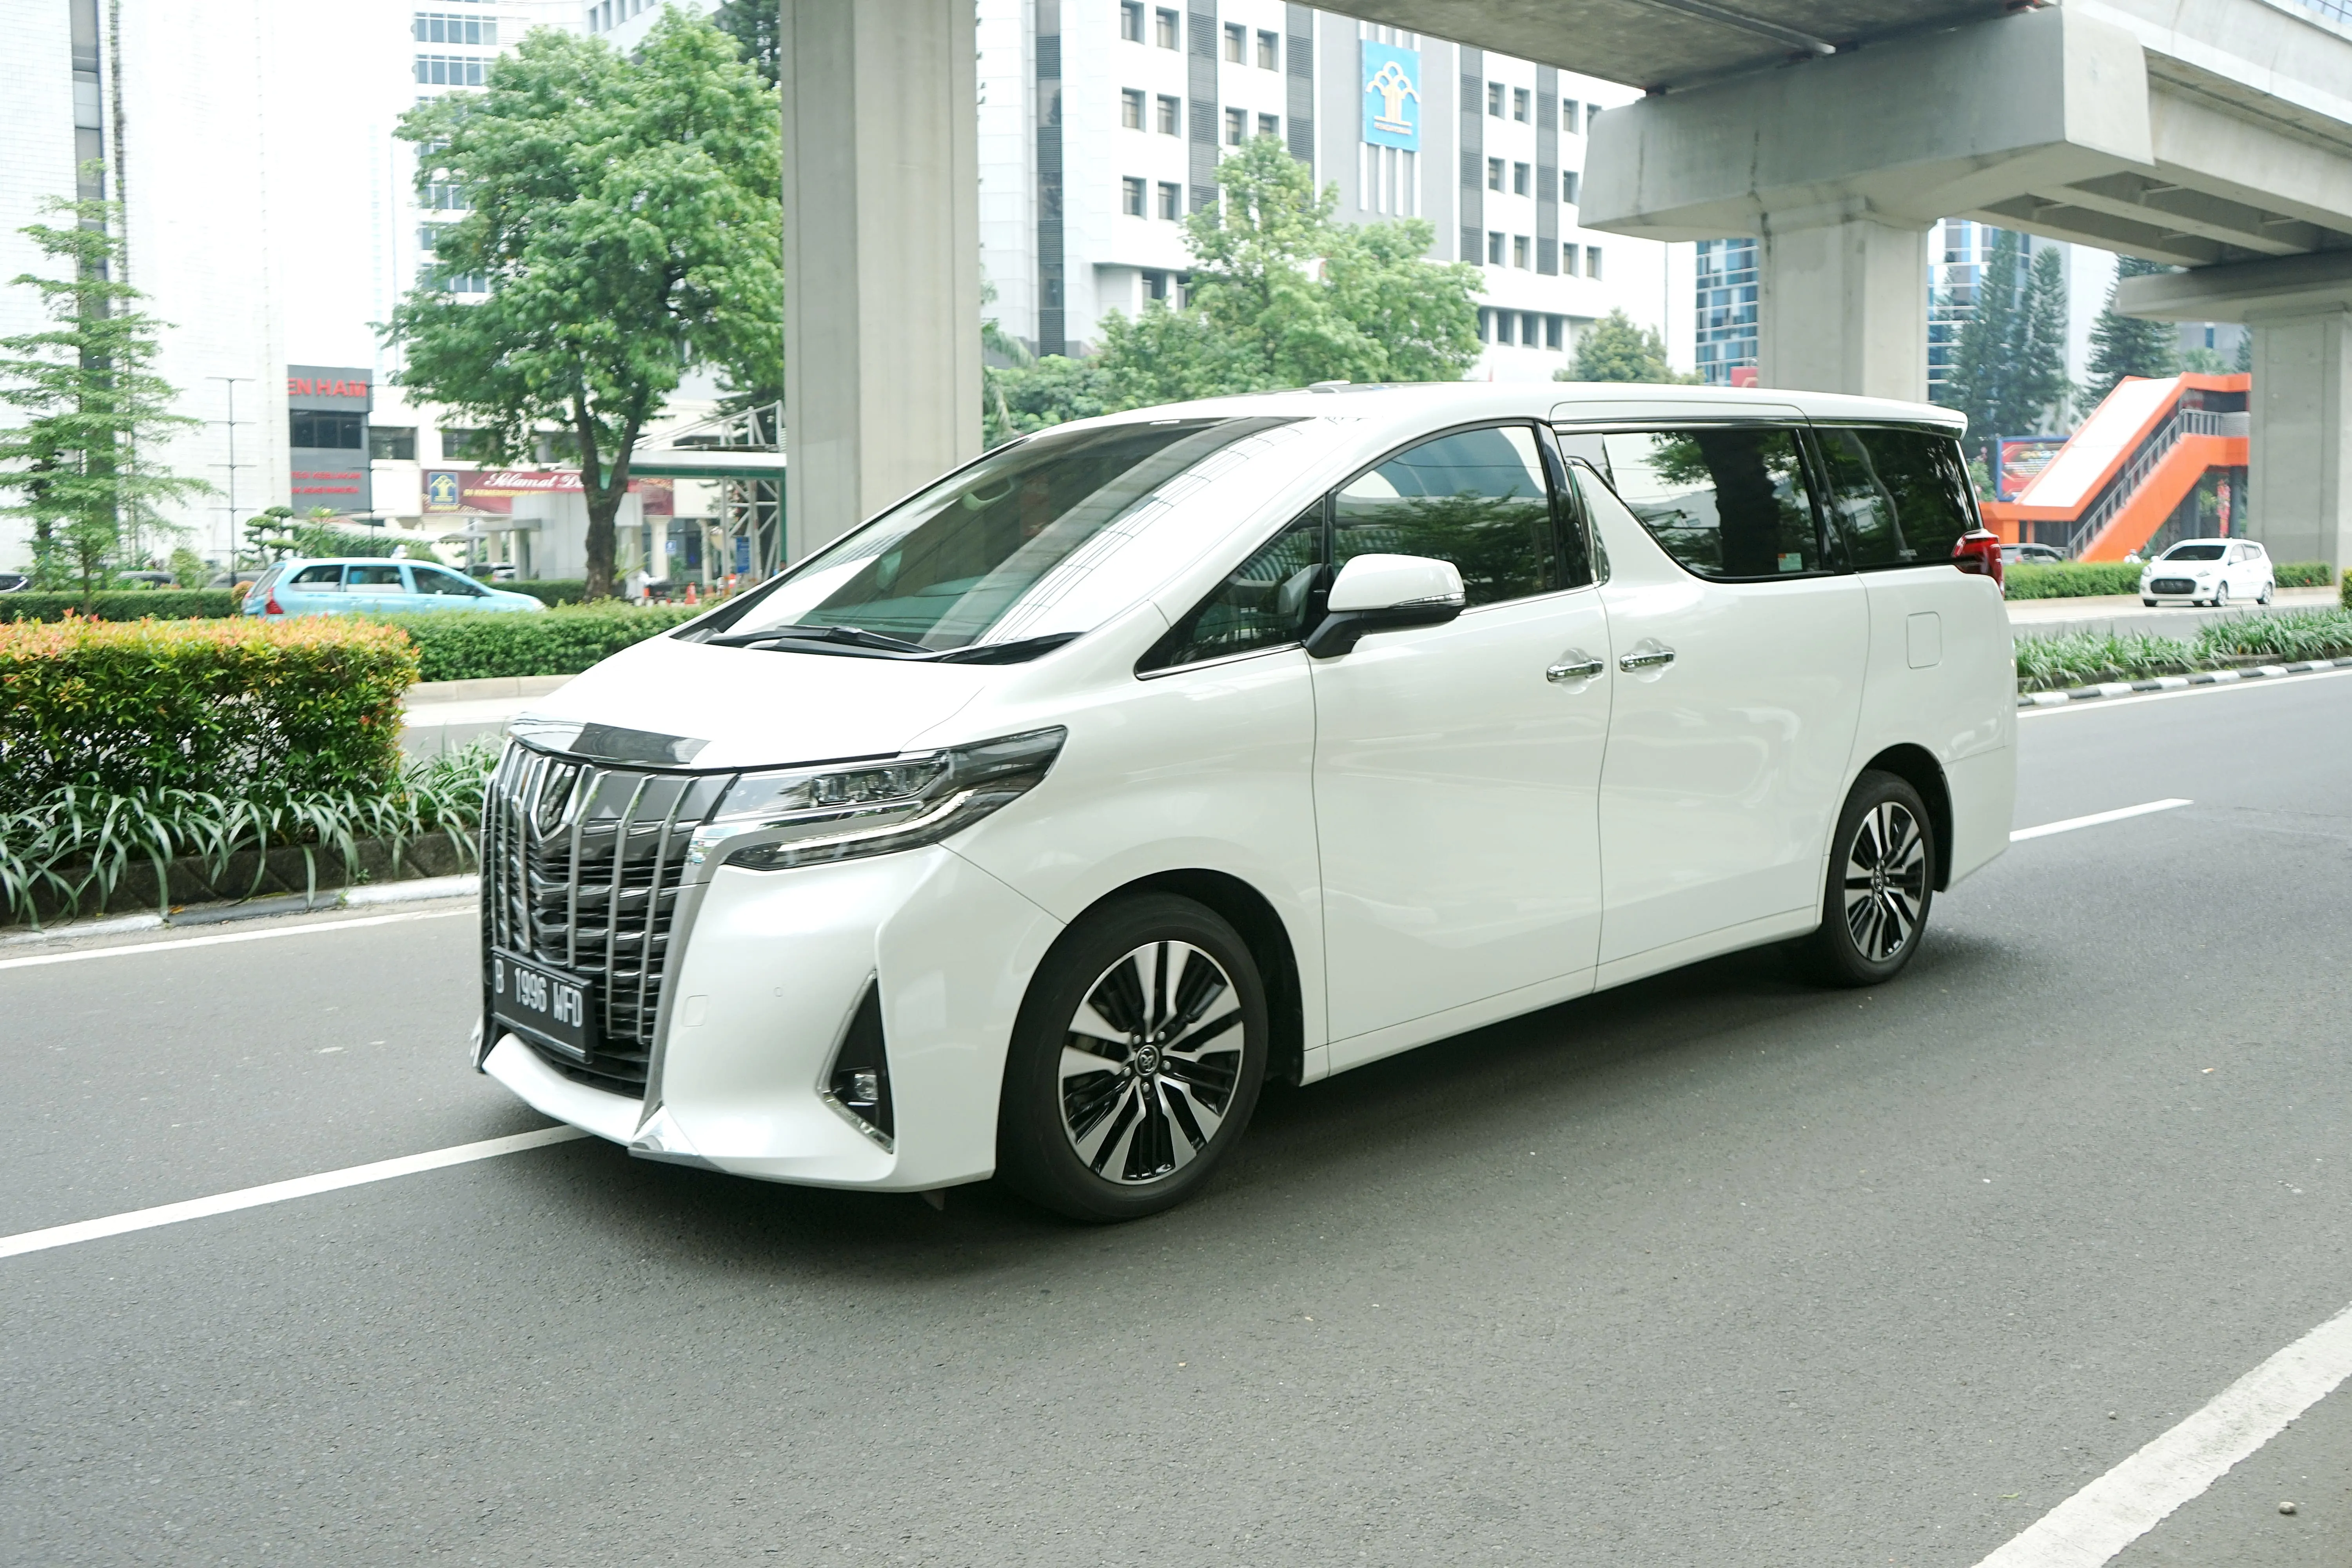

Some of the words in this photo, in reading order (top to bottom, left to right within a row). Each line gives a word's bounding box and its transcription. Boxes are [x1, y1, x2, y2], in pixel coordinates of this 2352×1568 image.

[316, 378, 367, 397] HAM
[483, 472, 558, 488] Selamat
[495, 959, 504, 993] B
[514, 967, 547, 1012] 1996
[553, 982, 583, 1027] WFD
